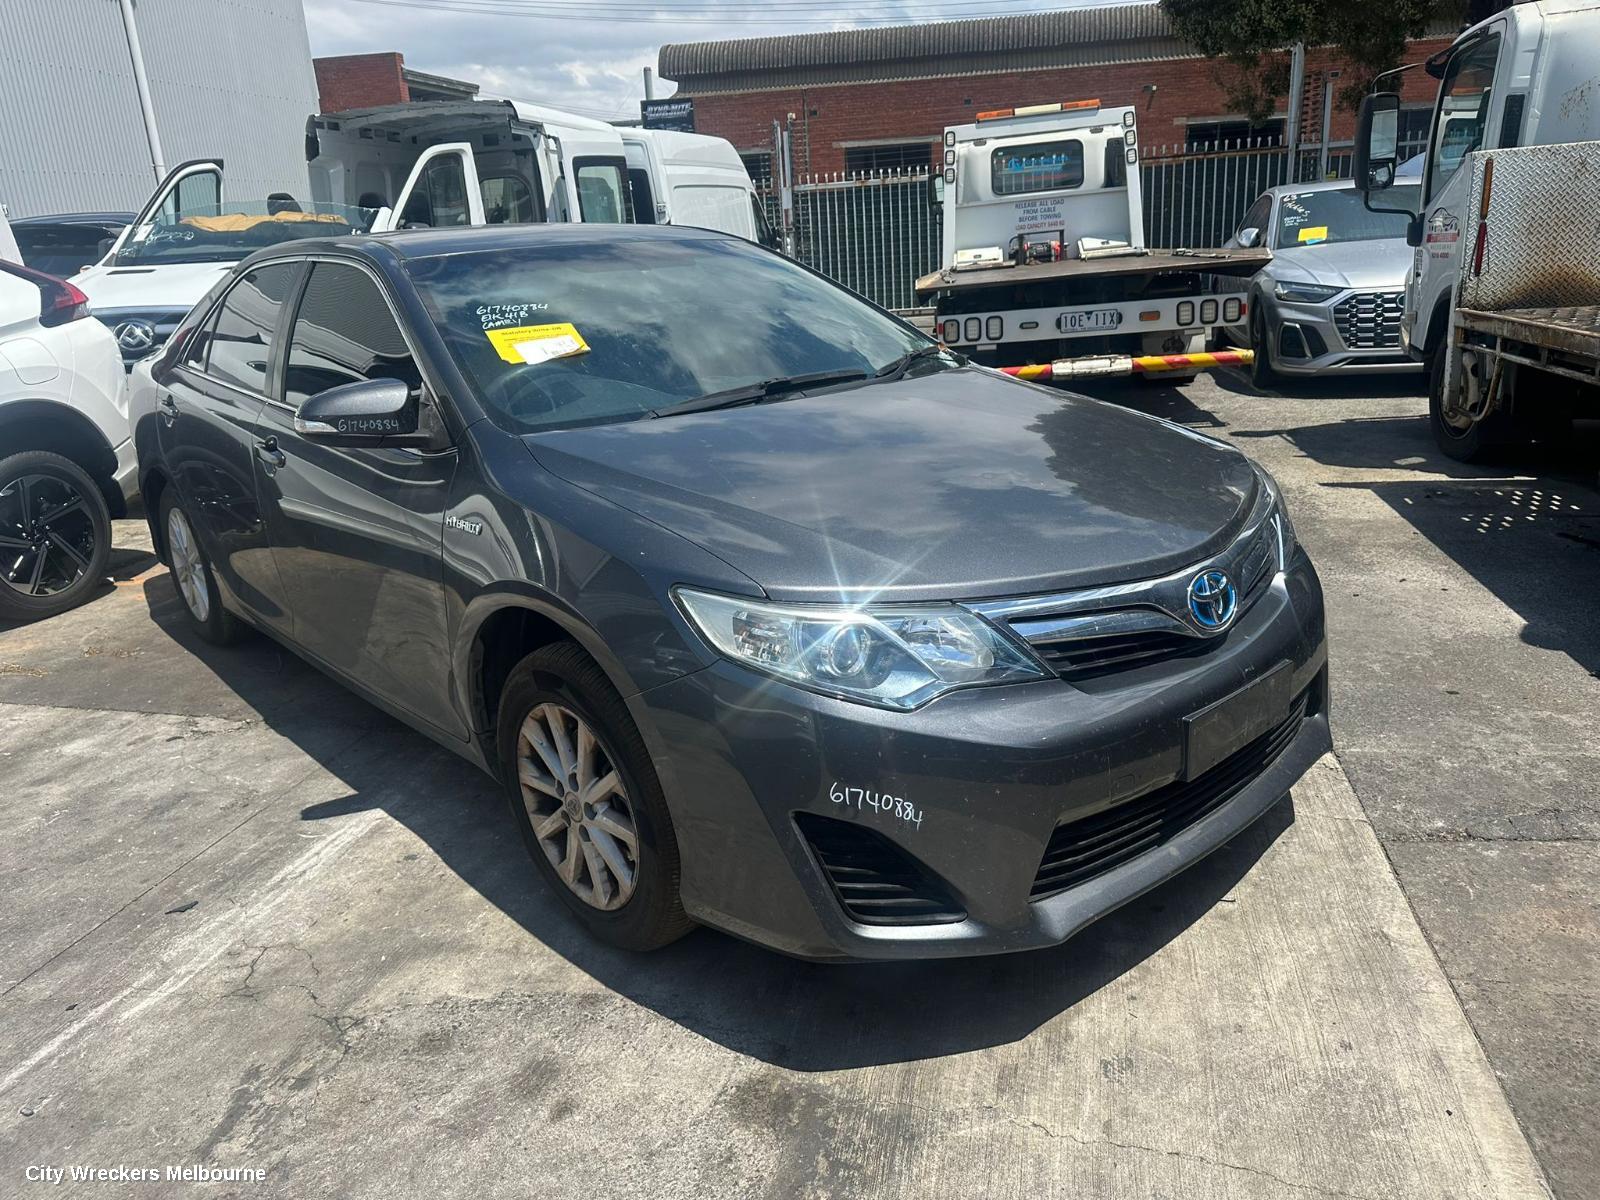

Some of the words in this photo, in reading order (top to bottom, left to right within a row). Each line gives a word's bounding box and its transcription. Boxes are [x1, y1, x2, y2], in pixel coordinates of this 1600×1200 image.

[1015, 201, 1037, 209] RELEASE
[1040, 212, 1061, 220] TOWING
[476, 304, 549, 315] 61740884
[338, 419, 400, 432] 61740884
[829, 781, 924, 831] 61740884
